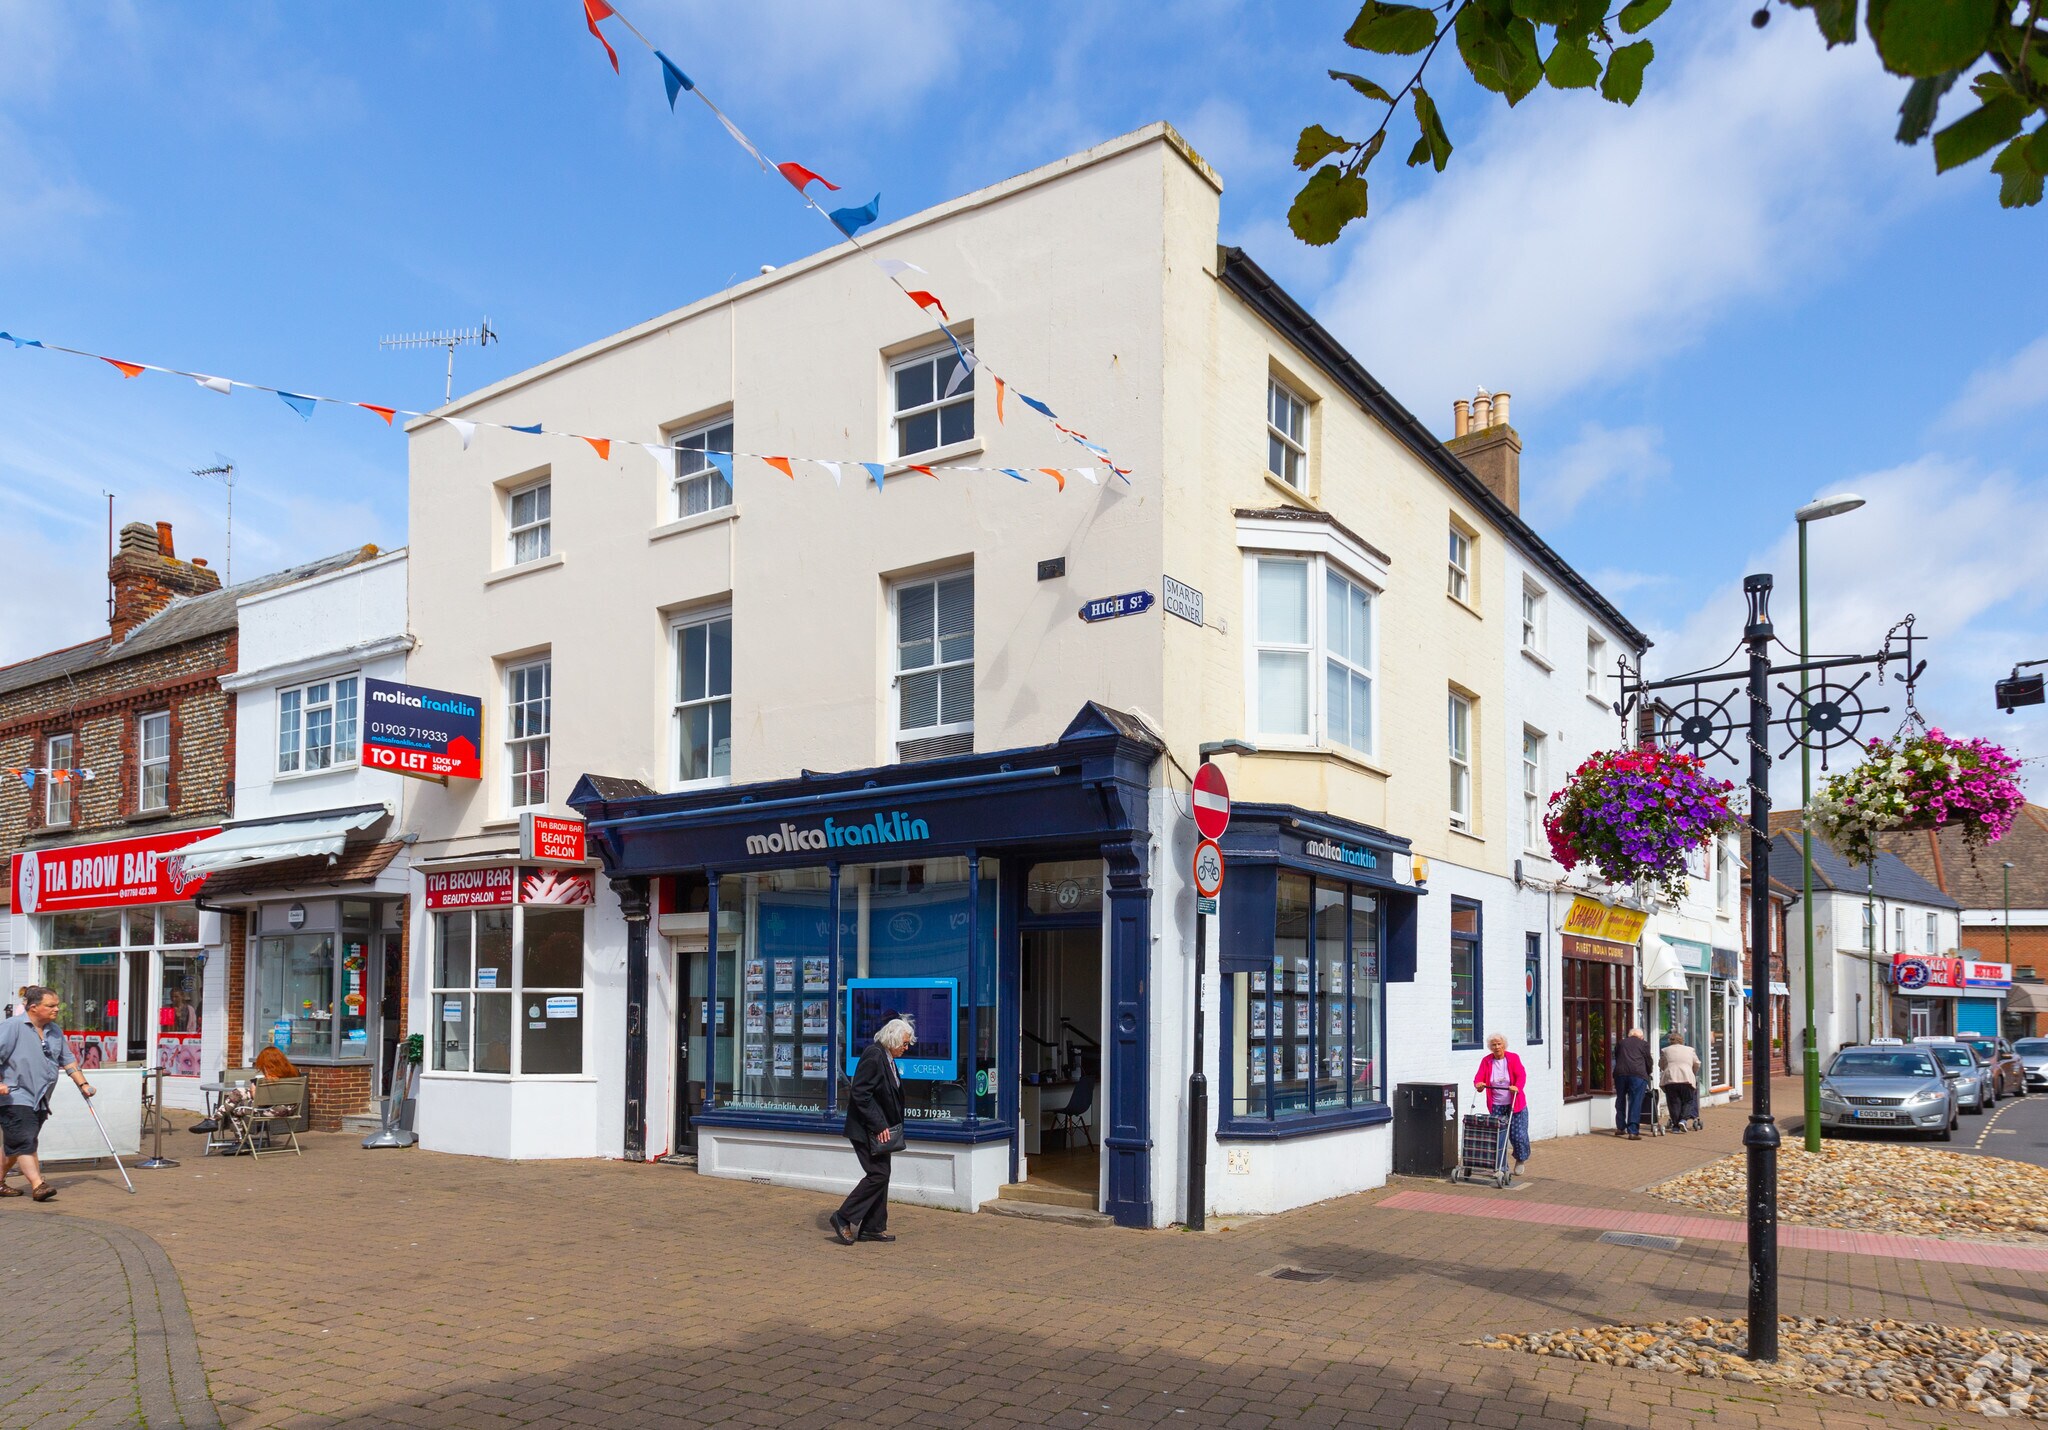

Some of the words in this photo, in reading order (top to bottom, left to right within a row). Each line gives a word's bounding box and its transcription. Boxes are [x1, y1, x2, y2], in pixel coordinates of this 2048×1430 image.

[1166, 579, 1200, 606] SMARTS
[1091, 598, 1124, 617] HIGH
[1166, 596, 1201, 623] CORNER
[372, 690, 475, 717] molicafranklin
[371, 722, 406, 737] 01903
[409, 727, 448, 743] 719333
[371, 735, 432, 749] molicafranklin.co.uk
[371, 747, 396, 765] TO
[401, 751, 427, 769] LET
[432, 756, 451, 765] LOCK
[432, 763, 453, 772] SHOP
[536, 820, 548, 829] TIA
[549, 822, 568, 831] BROW
[569, 824, 583, 833] BAR
[746, 811, 930, 855] molicafranklin
[541, 832, 577, 845] BEAUTY
[544, 845, 575, 858] SALON
[1306, 838, 1377, 869] molicafranklin
[44, 860, 67, 893] TIA
[71, 854, 120, 890] BROW
[123, 850, 157, 885] BAR
[428, 873, 447, 892] TIA
[449, 870, 484, 889] BROW
[486, 868, 511, 887] BAR
[442, 893, 470, 905] BEAUTY
[470, 891, 494, 903] SALON
[1059, 886, 1079, 904] 69
[1568, 903, 1607, 930] SHAHAN
[1575, 941, 1592, 955] FINEST
[1592, 943, 1607, 956] INDIAN
[1607, 946, 1624, 958] CUISINE
[913, 1064, 944, 1074] SCREEN
[723, 1099, 820, 1113] www.molicafranklin.co.uk
[904, 1107, 922, 1117] 1903
[924, 1108, 951, 1118] 719333
